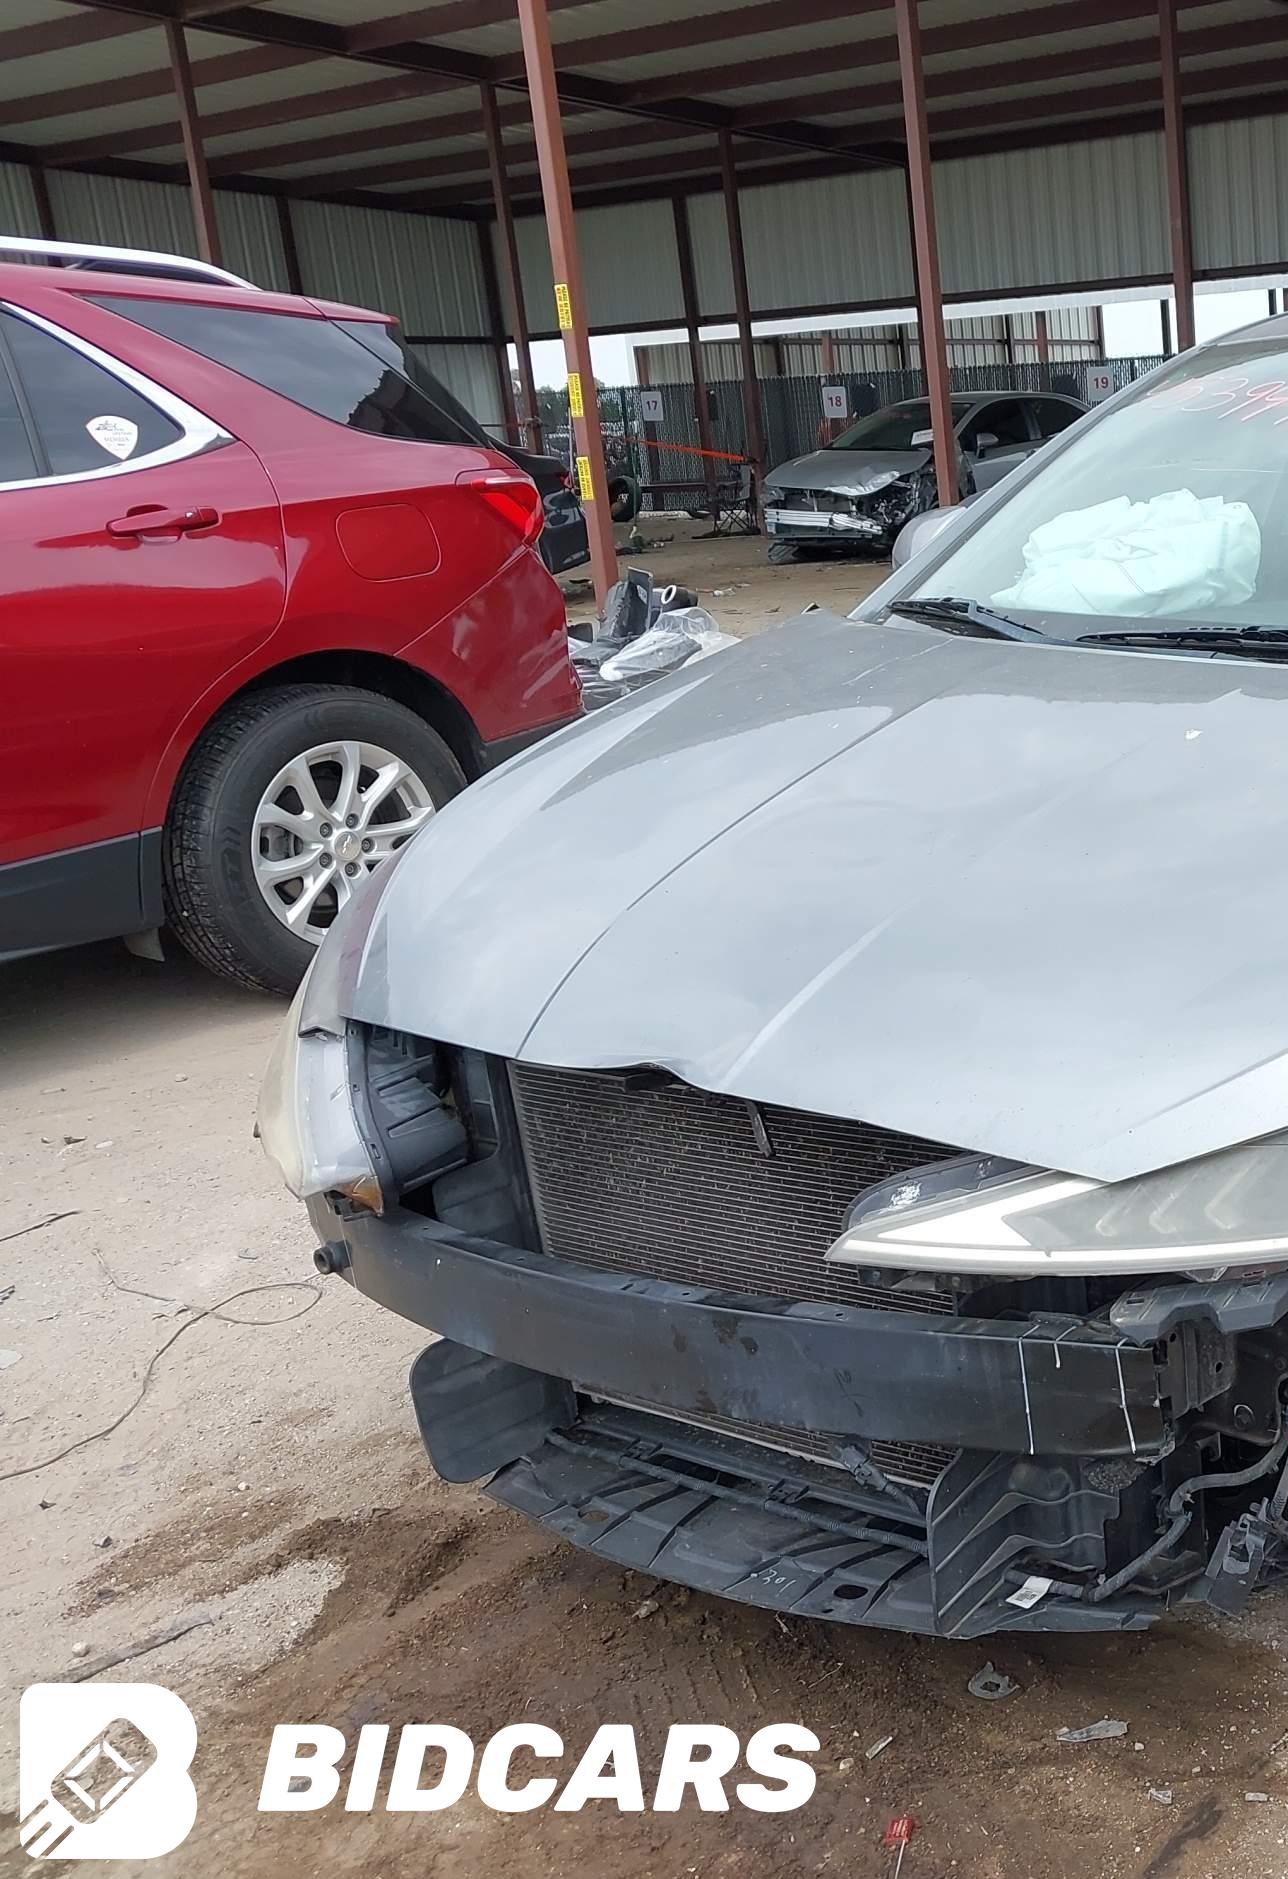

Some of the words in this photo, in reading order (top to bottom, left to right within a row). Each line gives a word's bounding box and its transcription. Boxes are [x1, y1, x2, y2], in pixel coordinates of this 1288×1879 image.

[1094, 376, 1109, 389] 19
[646, 400, 658, 410] 17
[828, 396, 842, 407] 18
